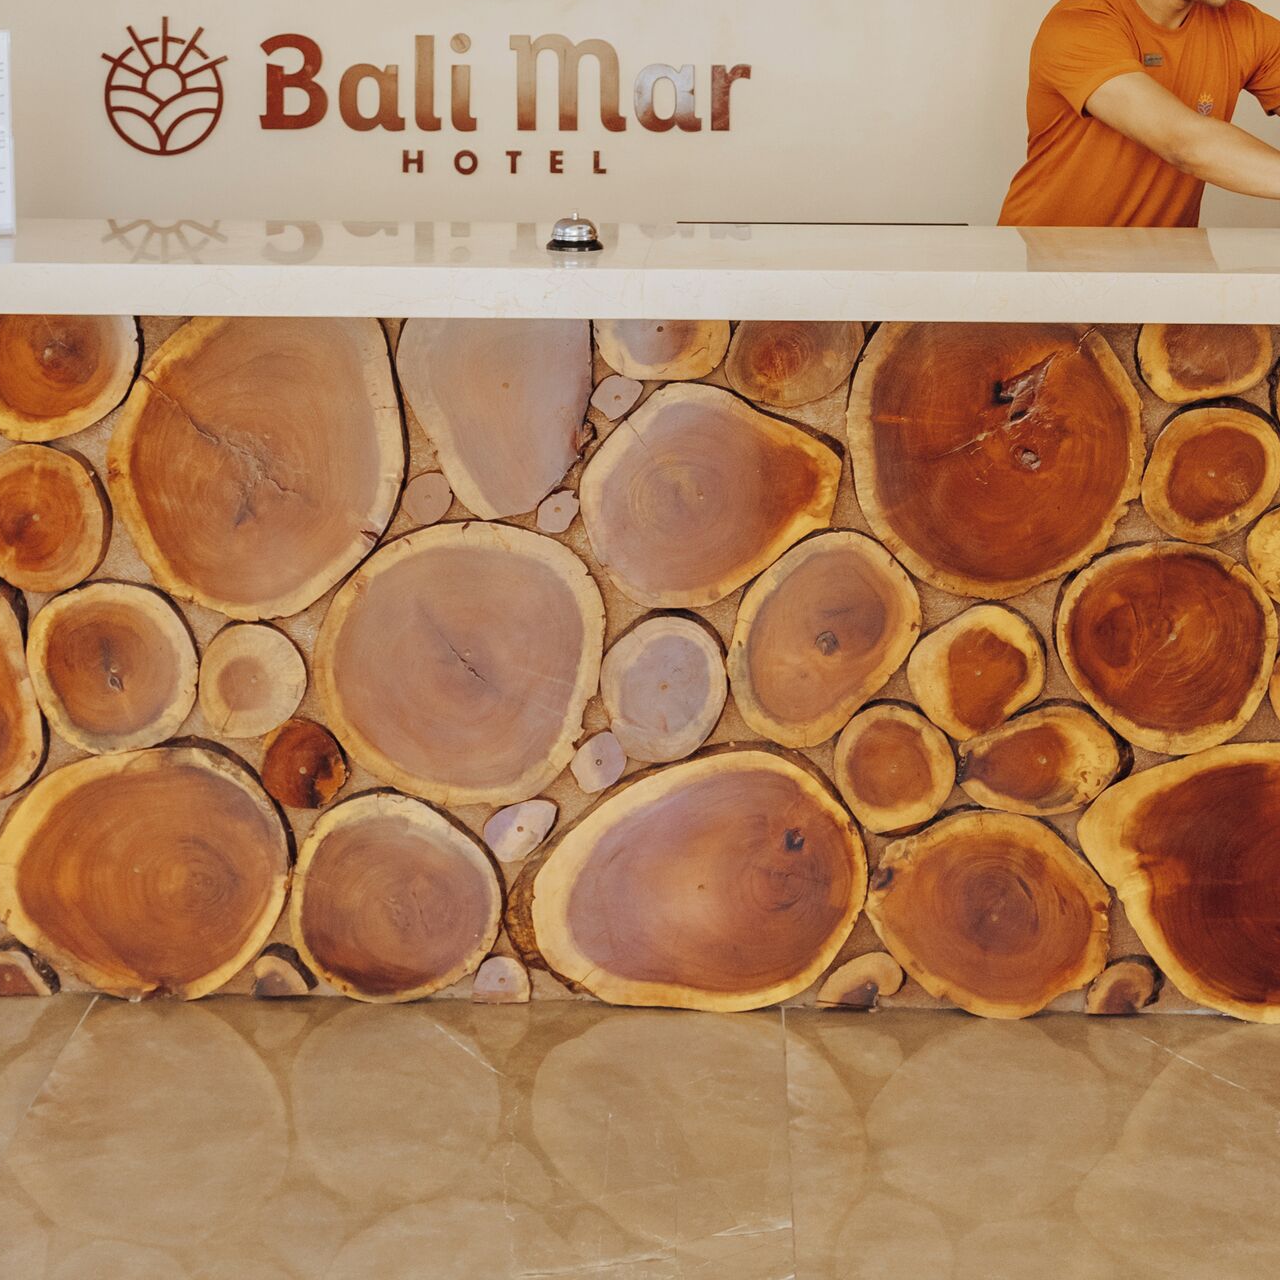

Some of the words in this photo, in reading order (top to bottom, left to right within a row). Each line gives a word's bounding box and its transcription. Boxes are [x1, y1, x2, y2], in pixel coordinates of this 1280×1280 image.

[259, 33, 478, 132] Bali
[509, 33, 753, 133] Mar
[402, 149, 607, 175] HOTEL
